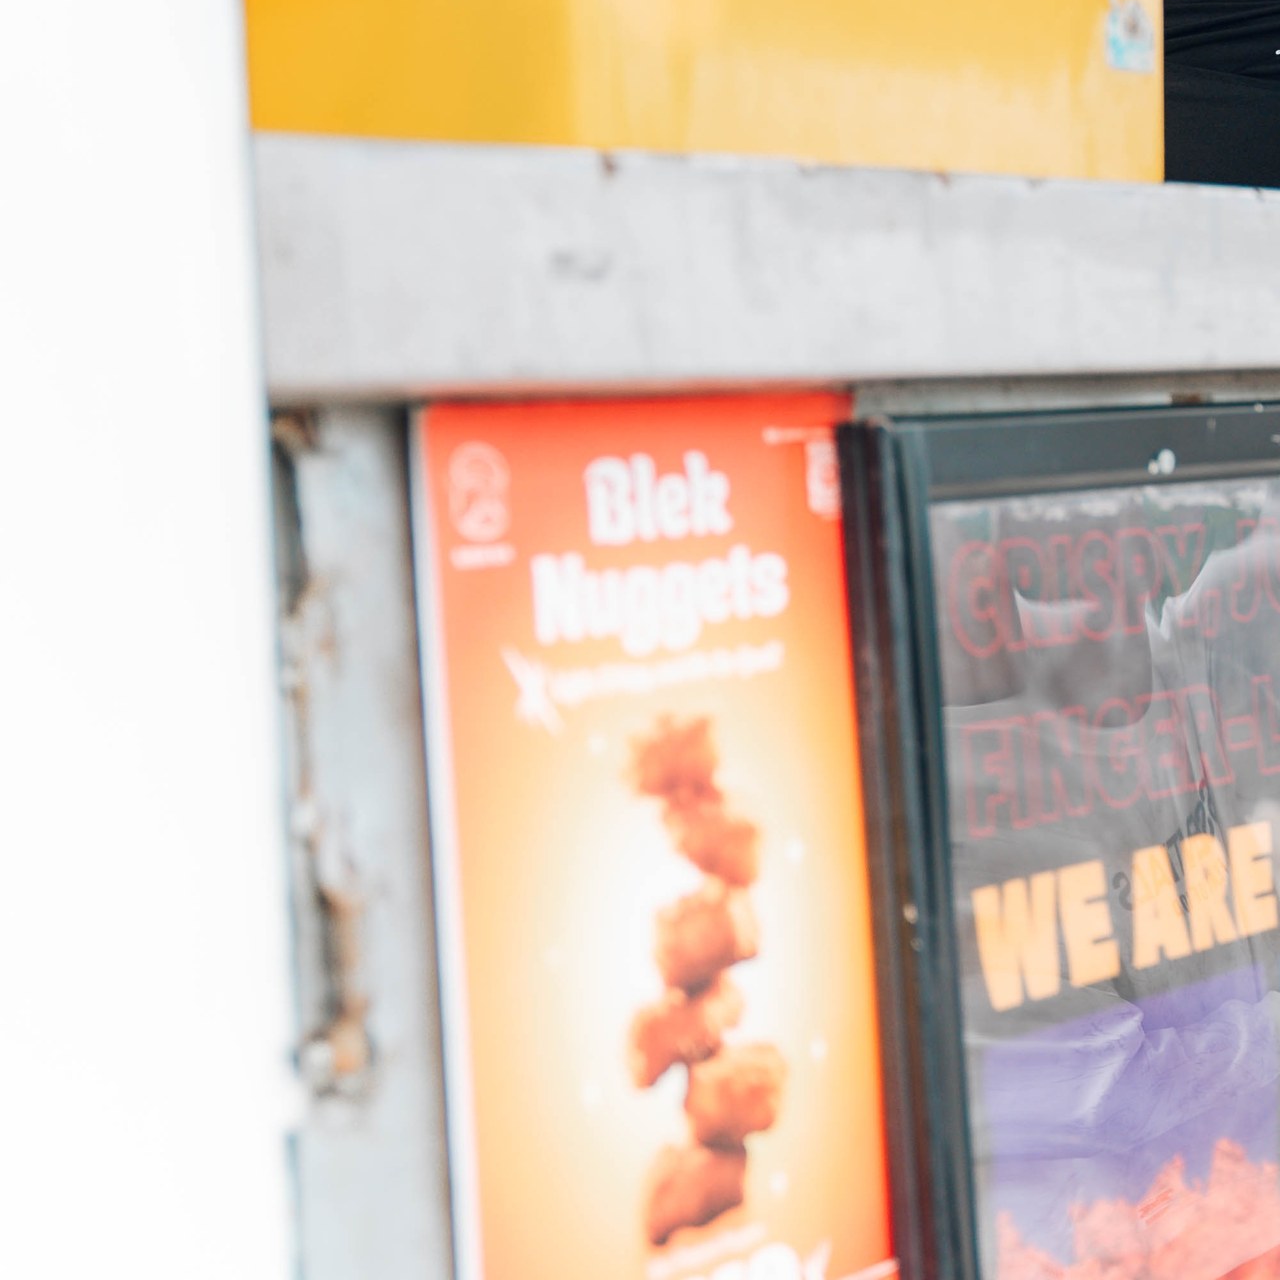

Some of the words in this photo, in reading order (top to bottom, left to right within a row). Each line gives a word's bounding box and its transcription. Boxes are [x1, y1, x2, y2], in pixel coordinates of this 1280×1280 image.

[531, 544, 790, 656] Nuggets
[971, 859, 1121, 1012] WE
[1132, 822, 1279, 969] ARE
